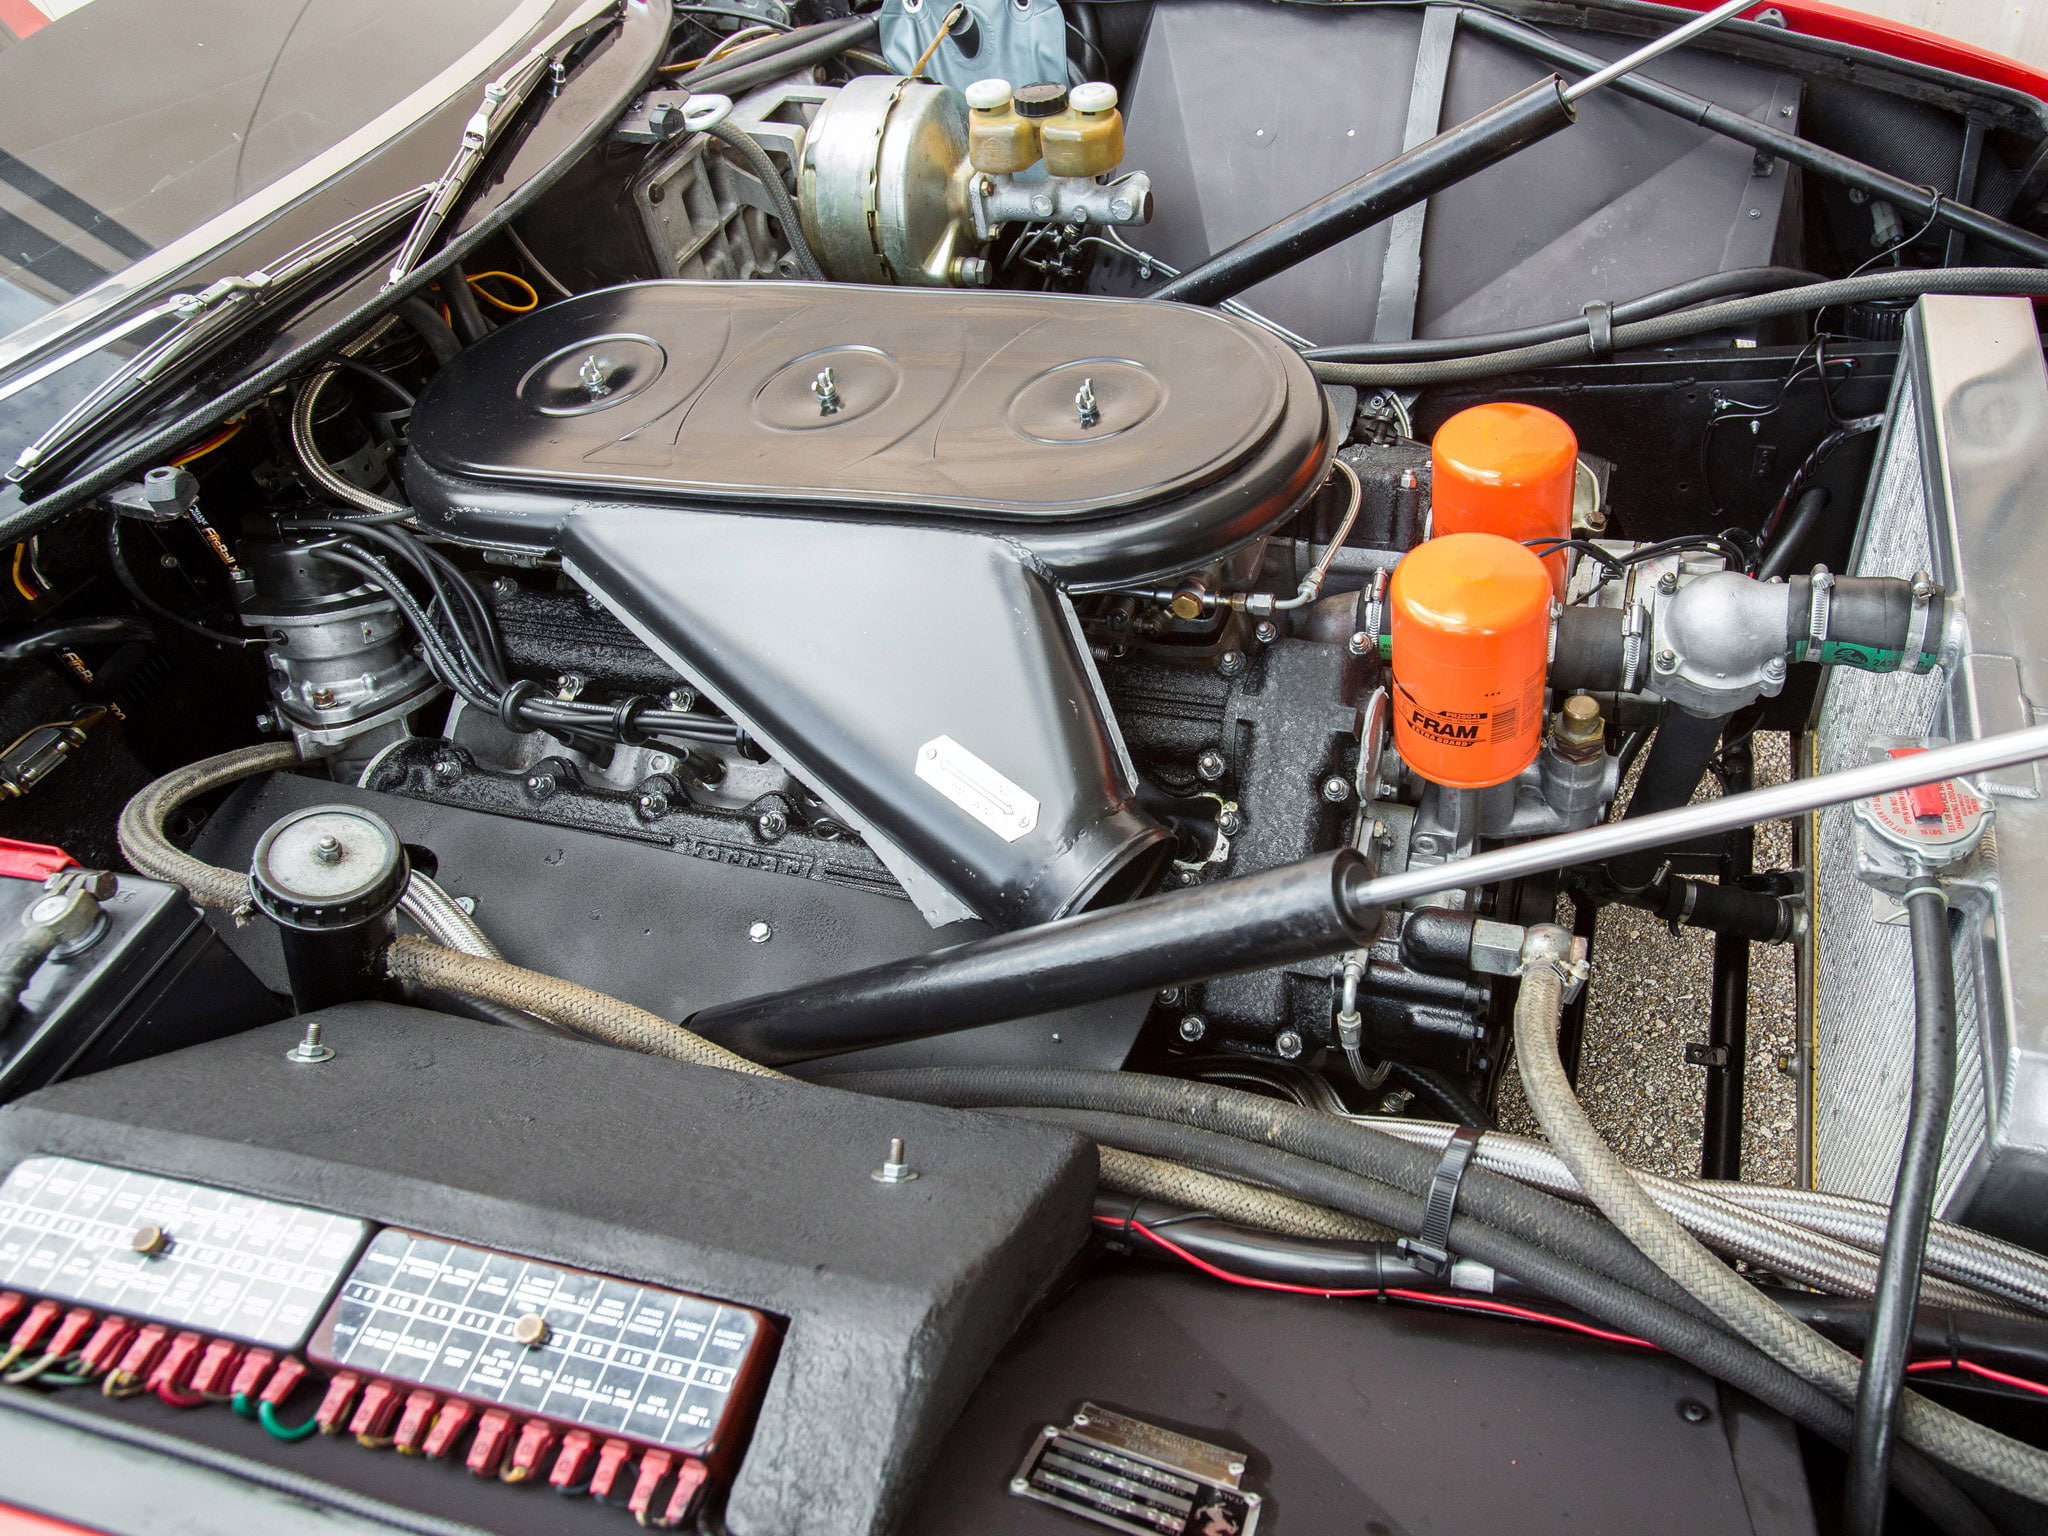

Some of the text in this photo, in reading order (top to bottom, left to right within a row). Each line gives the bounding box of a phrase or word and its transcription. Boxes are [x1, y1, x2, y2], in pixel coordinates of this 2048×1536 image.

[1412, 710, 1479, 740] FRAM
[1411, 724, 1469, 748] EXTRA GUARD
[1873, 803, 1882, 811] TO
[1888, 796, 1899, 807] NOT
[1898, 796, 1909, 811] WHEN
[1891, 807, 1901, 815] DO
[1902, 811, 1912, 825] OPEN
[1945, 813, 1953, 822] OR
[1951, 803, 1966, 830] CHANGING
[1877, 811, 1895, 827] LEVER
[1892, 825, 1908, 836] LIFT
[1946, 821, 1957, 834] TEST
[1214, 1490, 1245, 1505] ITALY
